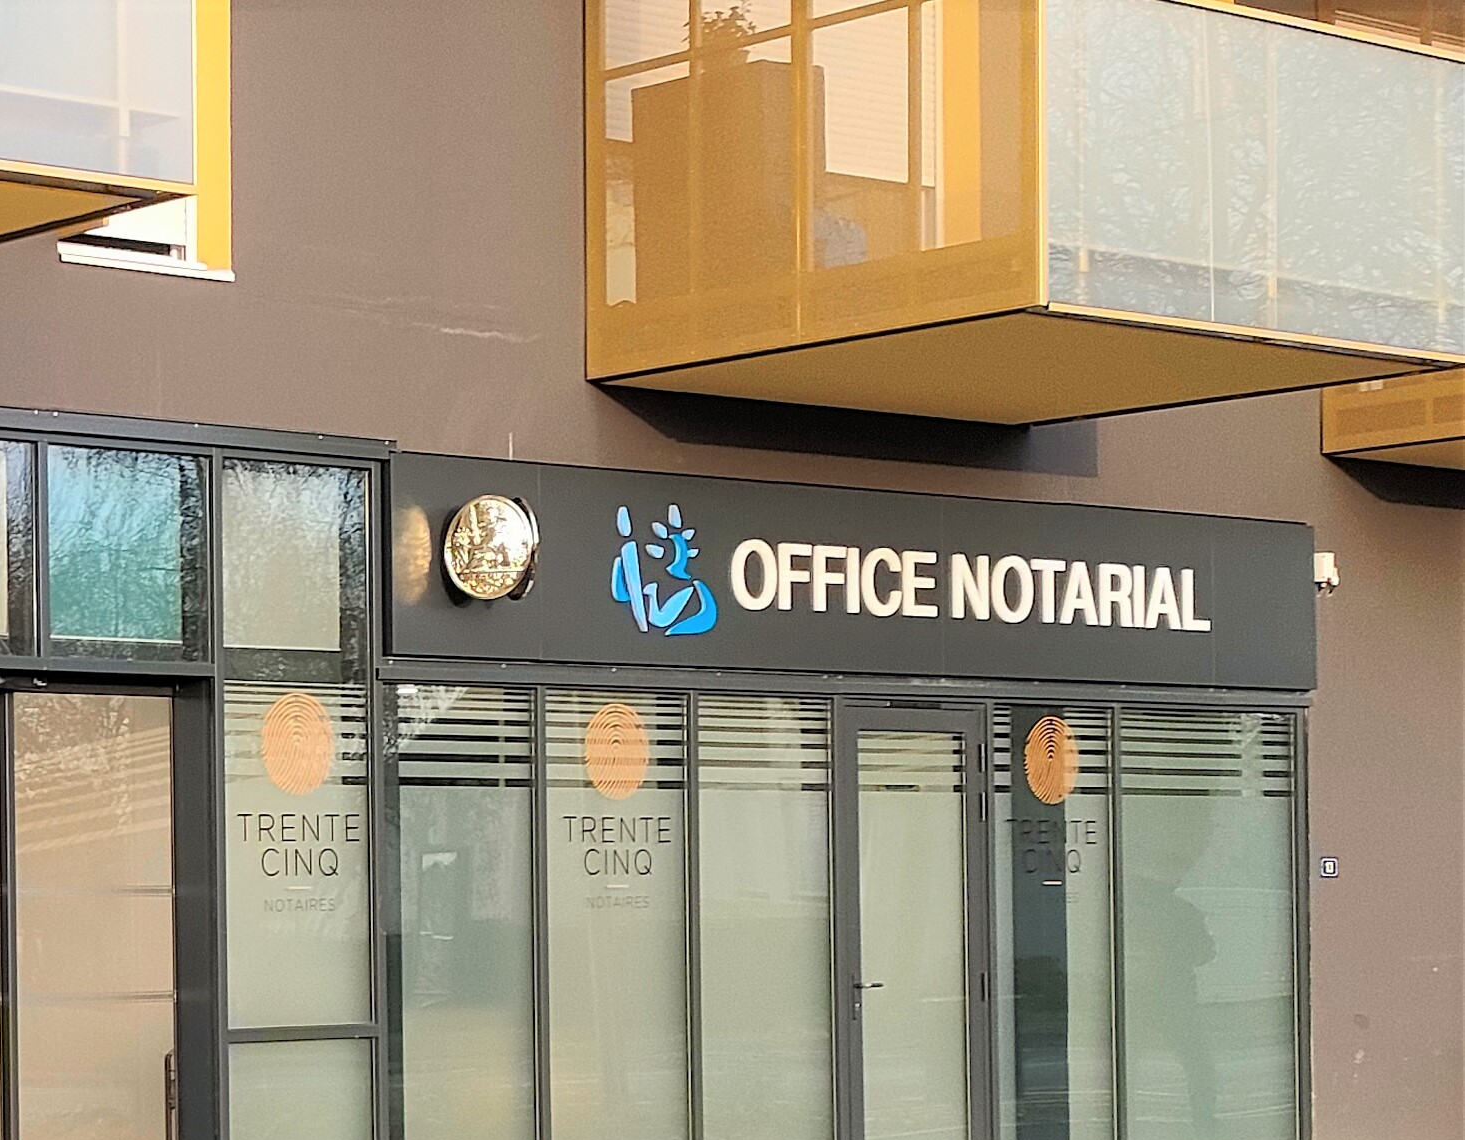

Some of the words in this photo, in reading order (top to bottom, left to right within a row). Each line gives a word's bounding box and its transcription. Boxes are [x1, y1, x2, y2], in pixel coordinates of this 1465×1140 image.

[730, 537, 938, 618] OFFICE
[950, 552, 1212, 632] NOTARIAL
[237, 813, 360, 842] TRENTE
[562, 816, 672, 843] TRENTE
[261, 848, 339, 877] CINQ
[584, 848, 652, 876] CINQ
[264, 898, 336, 912] NOTAIRES
